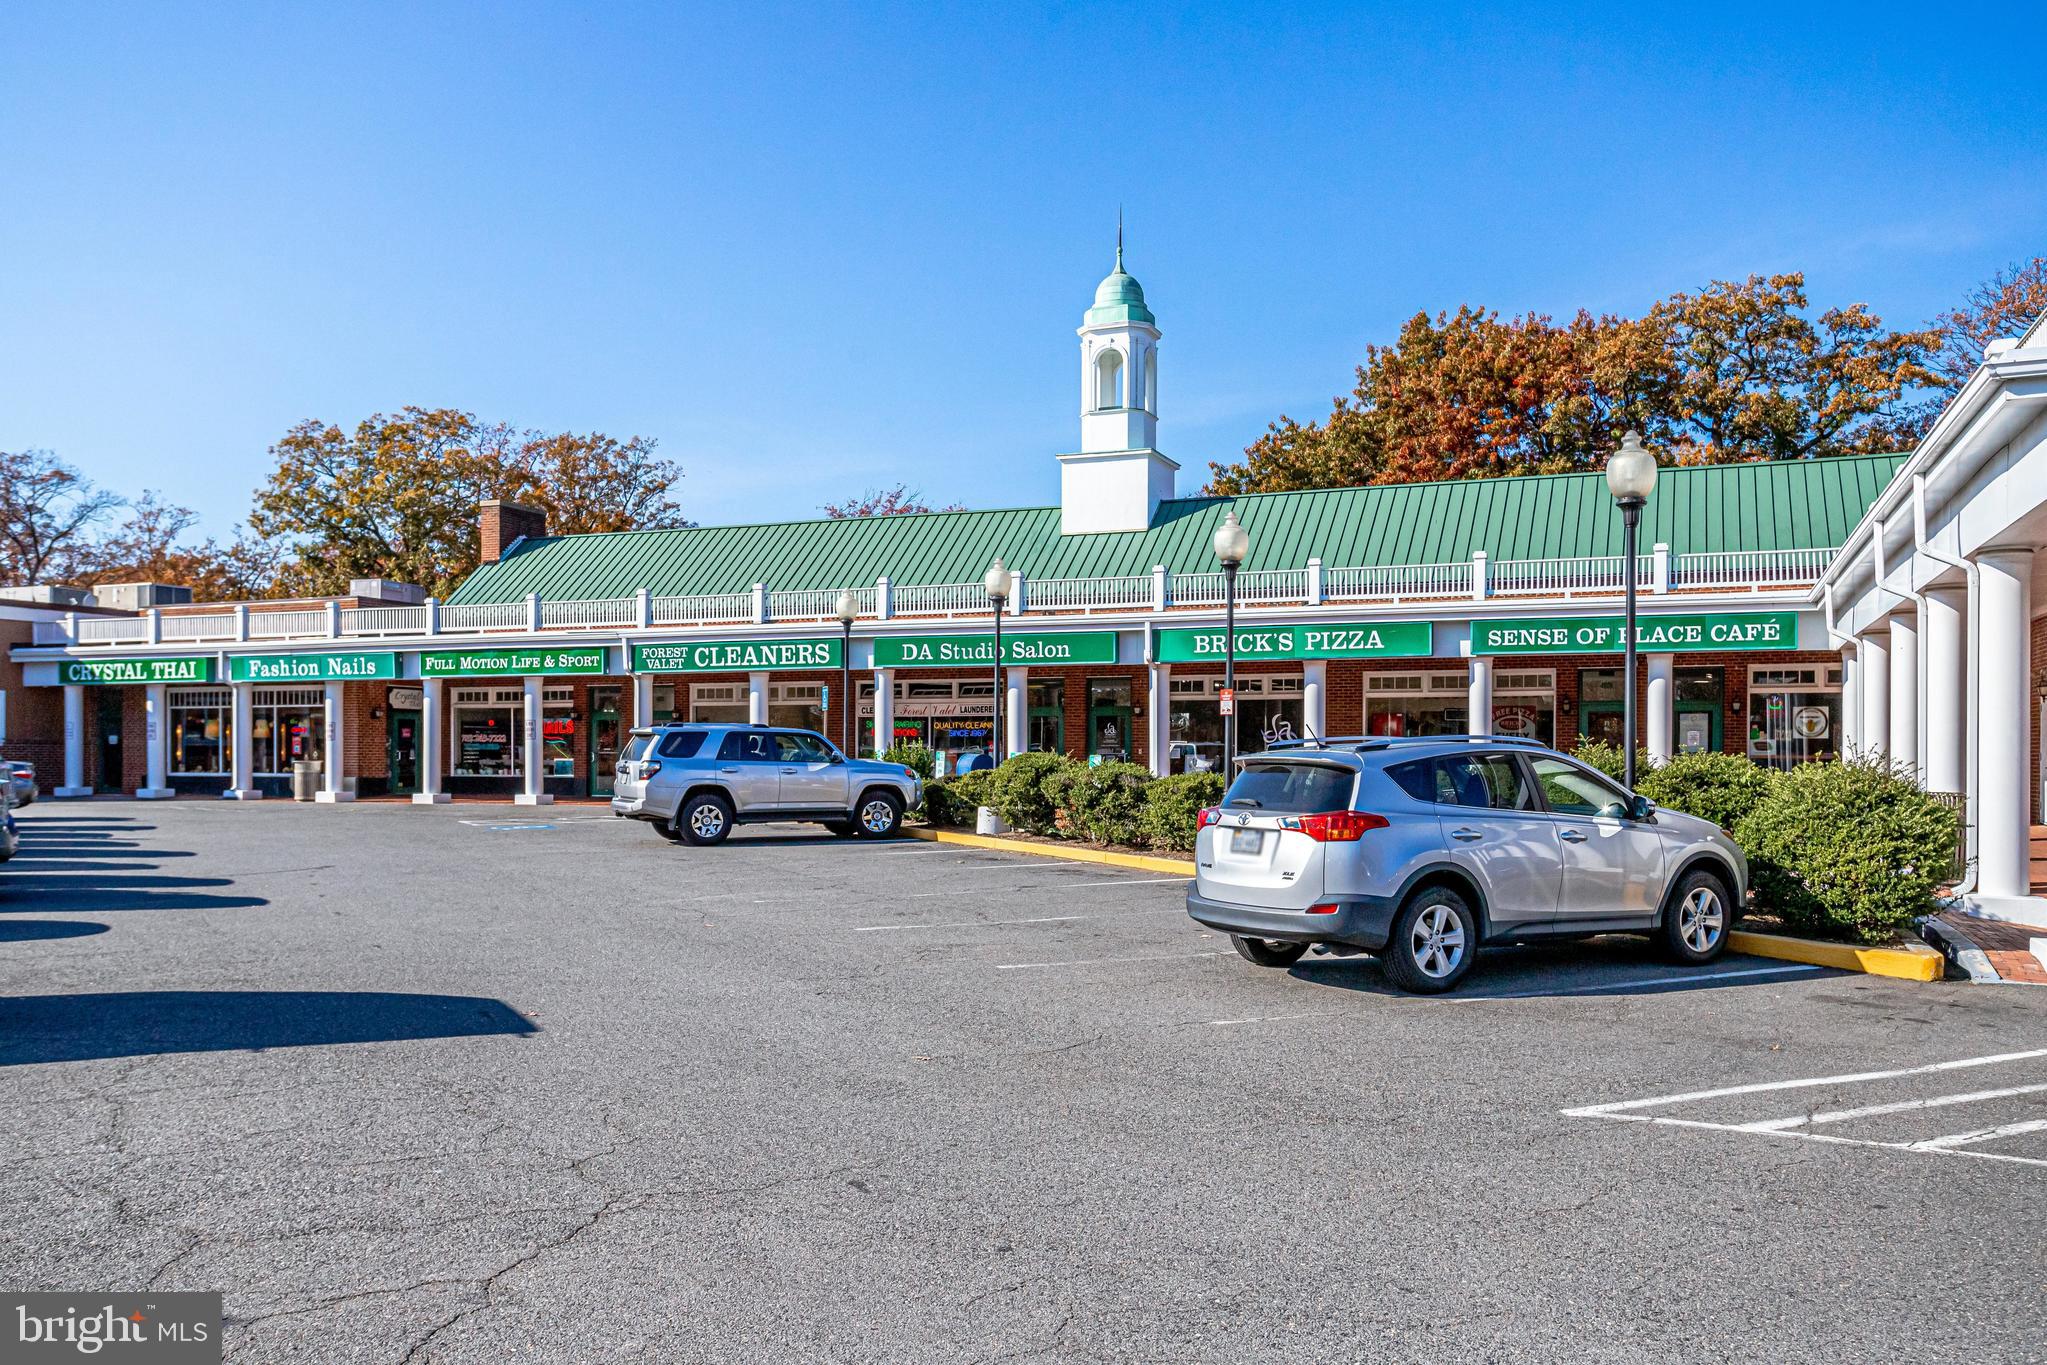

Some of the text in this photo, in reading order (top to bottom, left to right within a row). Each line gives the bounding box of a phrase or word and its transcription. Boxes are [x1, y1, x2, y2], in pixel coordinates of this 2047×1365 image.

[1304, 630, 1385, 650] PIZZA
[1488, 628, 1568, 646] SENSE
[1576, 627, 1610, 645] OF
[1710, 618, 1781, 642] CAFÉ
[641, 643, 830, 668] FOREST CLEANERS
[902, 641, 1071, 661] DA Studio Salon
[68, 661, 197, 681] CRYSTAL THAI
[248, 656, 376, 677] Fashion Nails
[425, 654, 600, 670] FULL MOTION LIFE & SPORT
[646, 658, 685, 669] VALET
